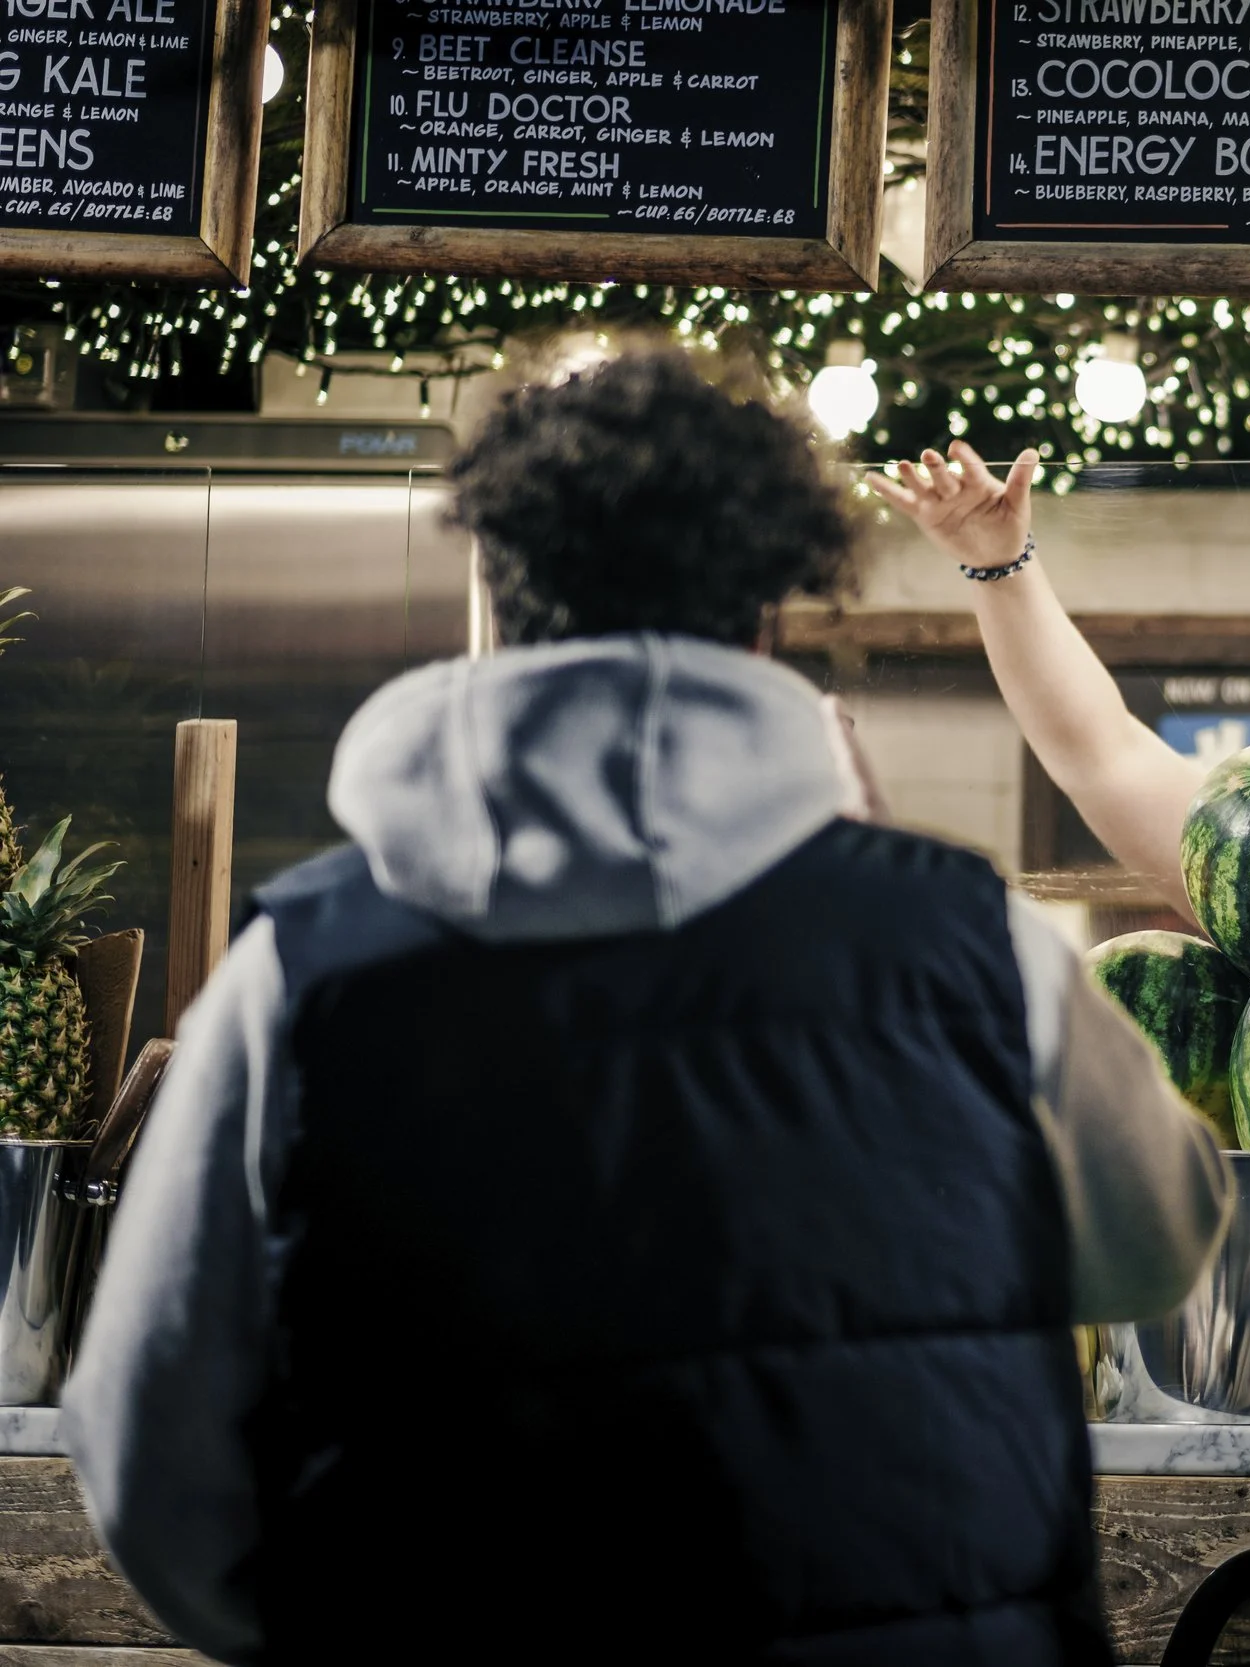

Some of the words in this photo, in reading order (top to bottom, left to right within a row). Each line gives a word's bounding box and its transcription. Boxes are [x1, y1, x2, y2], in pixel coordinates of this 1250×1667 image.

[427, 8, 551, 31] STRAWBERRY,
[559, 12, 612, 29] APPLE
[620, 12, 631, 32] &
[640, 15, 703, 33] LEMON
[1013, 4, 1032, 22] 12.
[7, 28, 73, 48] GINGER,
[78, 30, 136, 48] LEMON
[138, 33, 147, 52] &
[150, 34, 189, 50] LIME
[392, 37, 406, 61] 9.
[418, 34, 491, 63] BEET
[510, 36, 647, 68] CLEANSE
[1036, 33, 1144, 54] STRAWBERRY,
[1151, 35, 1242, 53] PINEAPPLE,
[43, 54, 147, 98] KALE
[423, 65, 516, 86] BEETROOT,
[523, 69, 598, 89] GINGER,
[605, 71, 664, 87] APPLE
[672, 70, 683, 91] &
[687, 74, 759, 91] CARROT
[1011, 78, 1032, 98] 13.
[62, 102, 73, 122] &
[80, 105, 139, 123] LEMON
[390, 94, 409, 116] 10.
[416, 89, 469, 118] FLU
[487, 92, 633, 124] DOCTOR
[1037, 109, 1130, 128] PINEAPPLE,
[1137, 110, 1214, 130] BANANA,
[419, 120, 504, 142] ORANGE,
[513, 123, 587, 144] CARROT,
[596, 127, 672, 145] GINGER
[680, 126, 692, 149] &
[700, 129, 775, 148] LEMON
[387, 152, 404, 173] 11.
[410, 146, 508, 175] MINTY
[523, 149, 620, 180] FRESH
[1009, 152, 1030, 175] 14.
[1035, 134, 1197, 177] ENERGY
[62, 179, 135, 198] AVOCADO
[137, 183, 145, 199] &
[150, 182, 186, 200] LIME
[414, 176, 476, 197] APPLE,
[484, 179, 563, 199] ORANGE,
[570, 182, 614, 197] MINT
[622, 180, 631, 200] &
[639, 183, 703, 201] LEMON
[1035, 184, 1129, 204] BLUEBERRY,
[1134, 185, 1237, 206] RASPBERRY,
